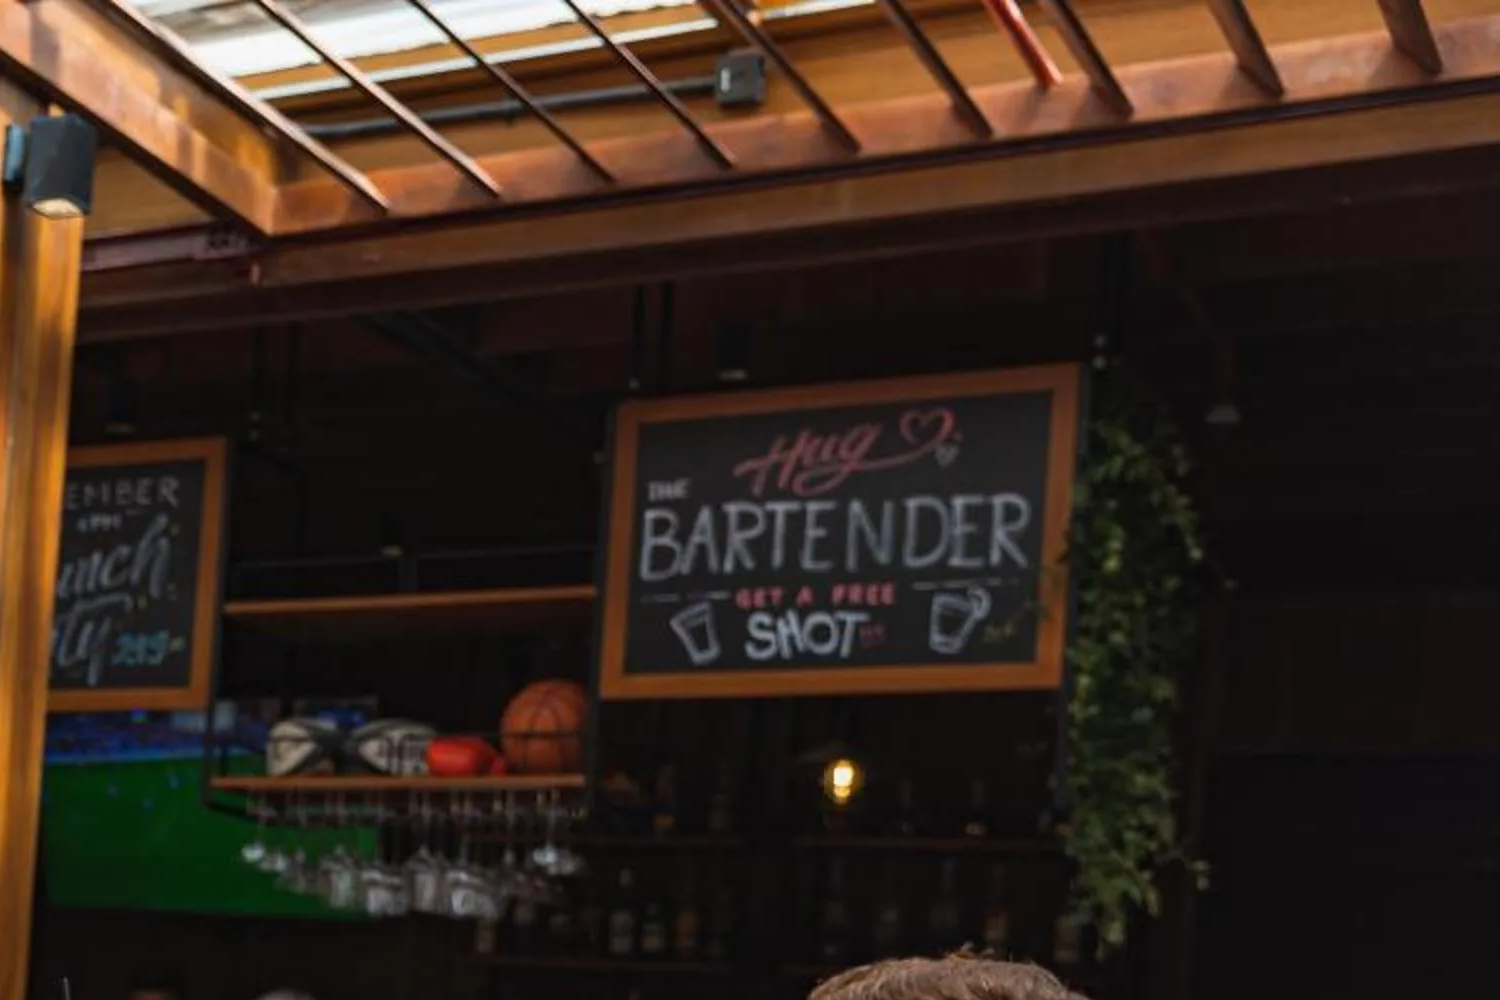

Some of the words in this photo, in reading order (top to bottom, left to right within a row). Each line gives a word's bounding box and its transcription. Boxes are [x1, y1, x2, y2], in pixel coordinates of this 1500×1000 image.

[732, 422, 888, 497] Hug
[647, 479, 691, 500] THE
[640, 494, 1031, 582] BARTENDER
[735, 585, 784, 611] GET
[795, 583, 814, 607] A
[831, 578, 896, 606] FREE
[745, 608, 870, 661] SHOT
